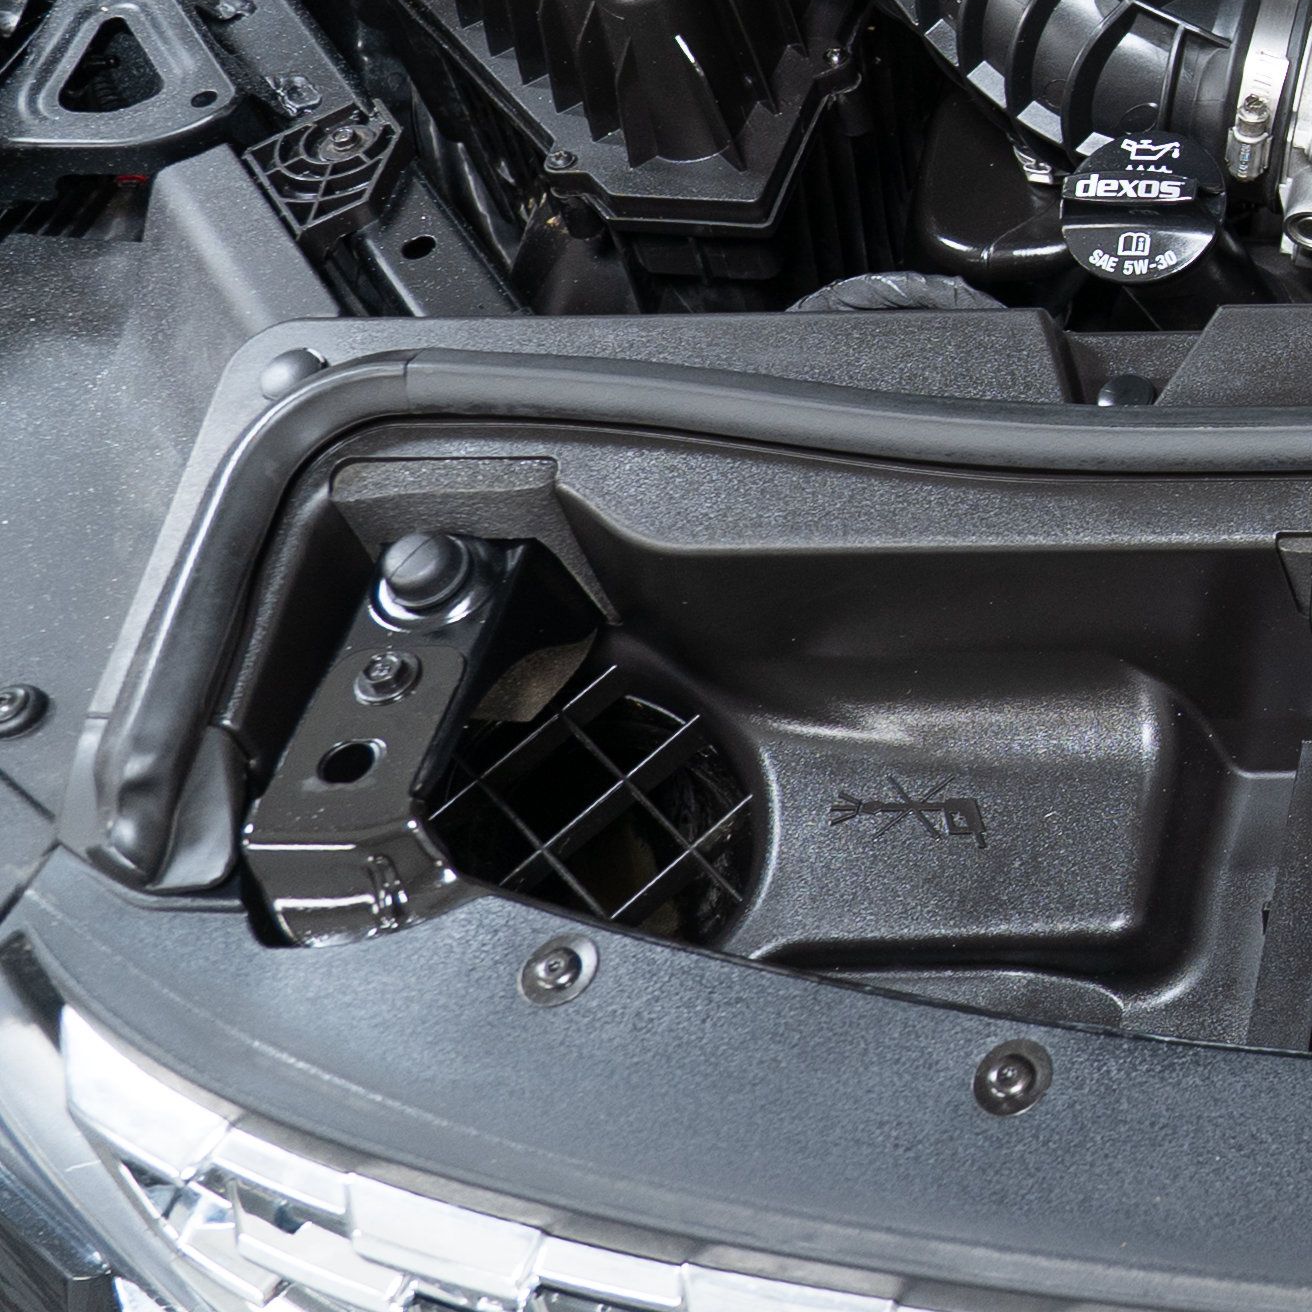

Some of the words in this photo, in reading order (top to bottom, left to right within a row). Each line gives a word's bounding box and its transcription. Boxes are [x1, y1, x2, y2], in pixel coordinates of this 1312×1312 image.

[1075, 174, 1182, 198] dexos
[1089, 249, 1118, 273] SAE
[1123, 250, 1178, 276] 5W-30
